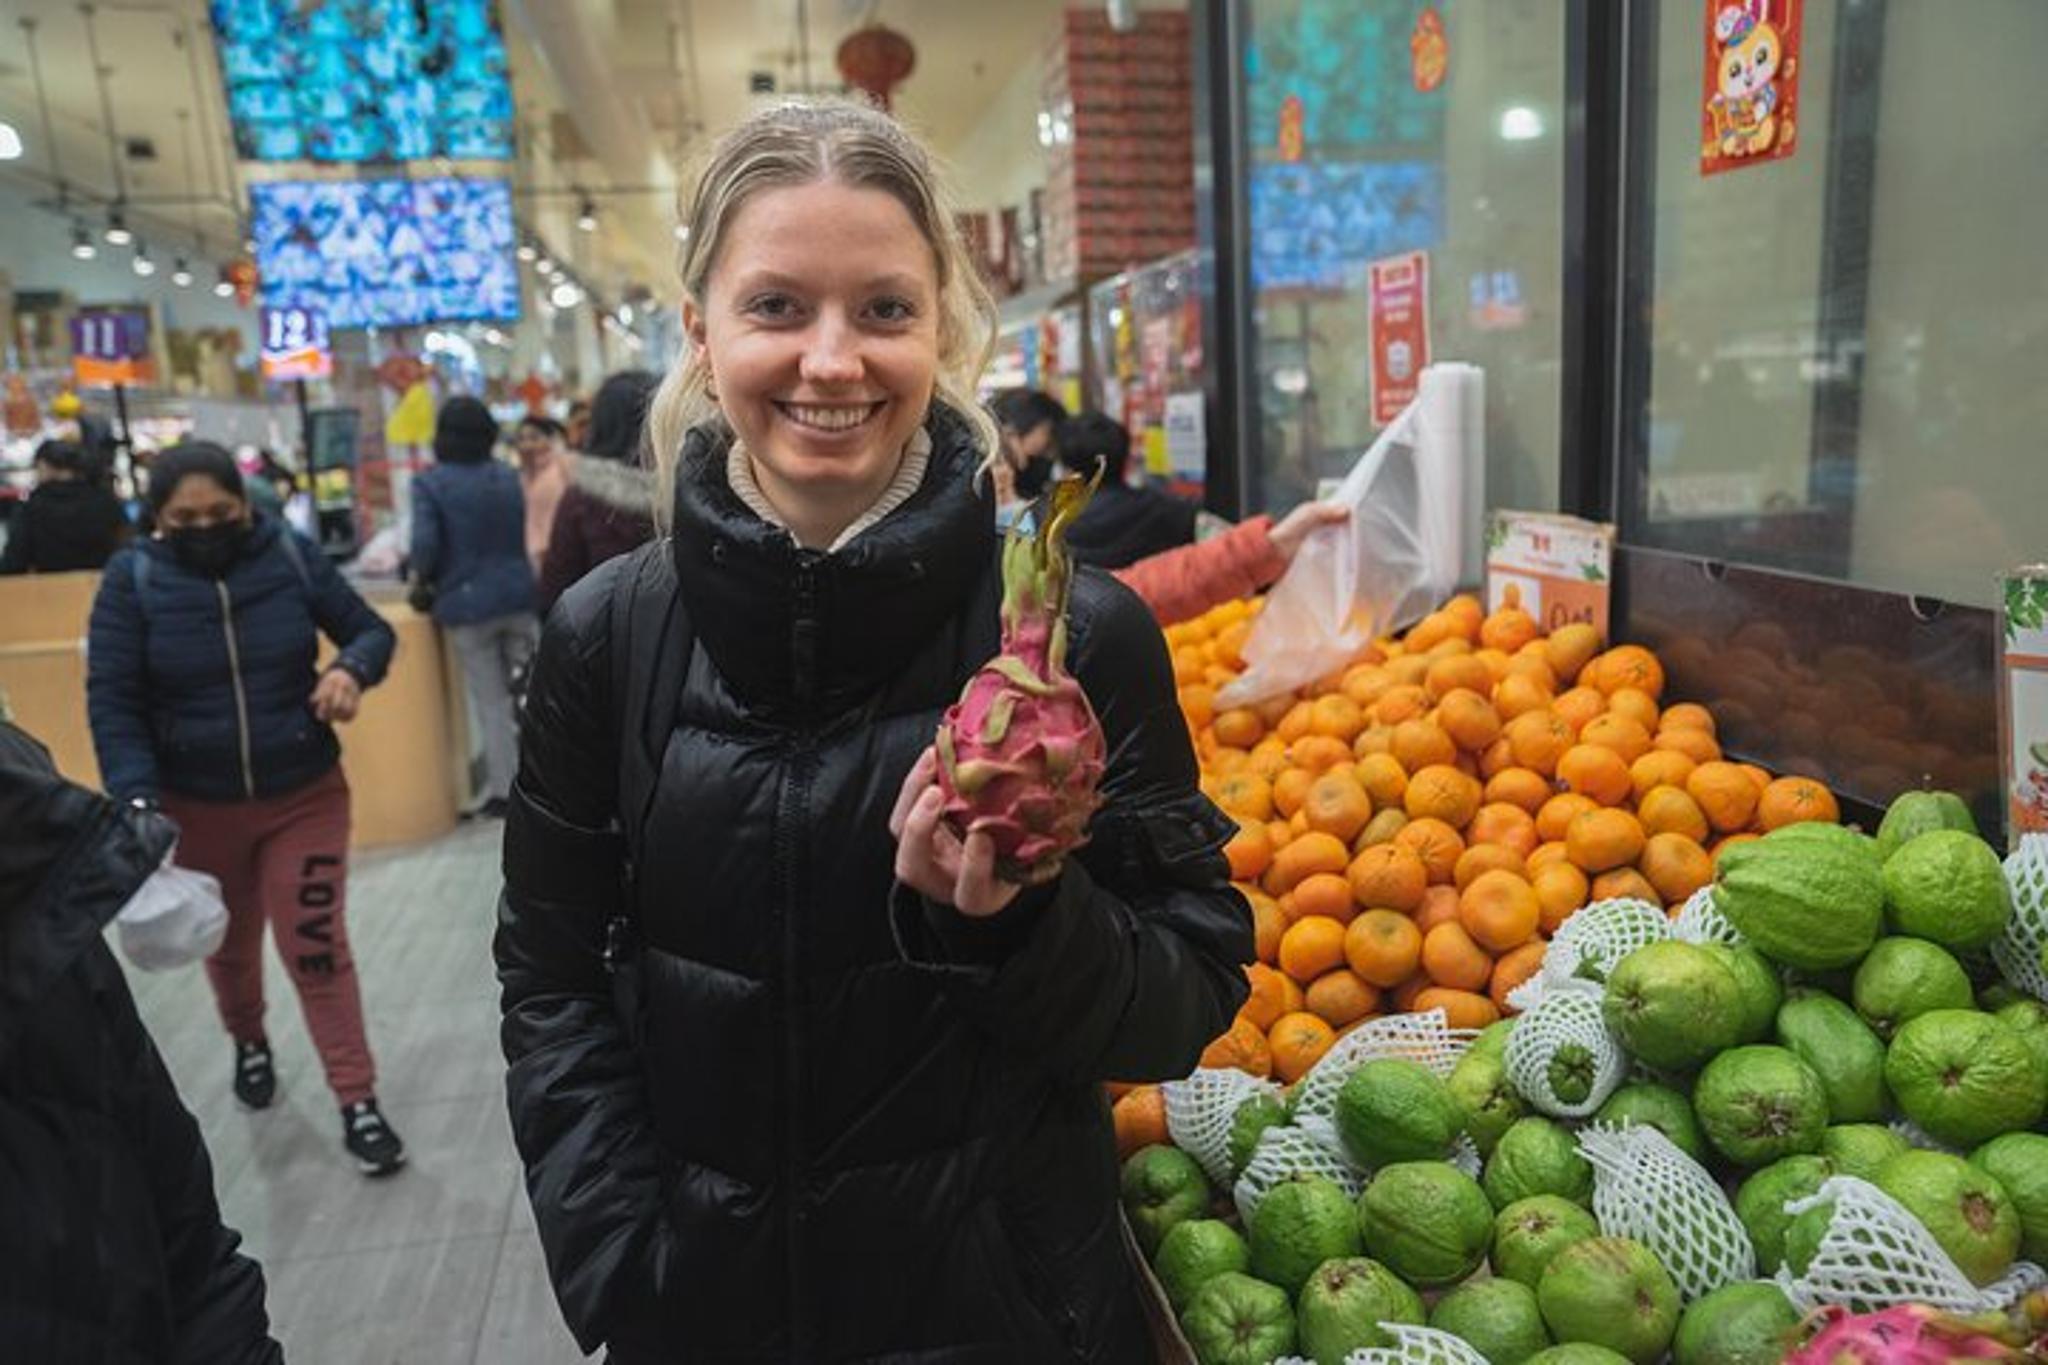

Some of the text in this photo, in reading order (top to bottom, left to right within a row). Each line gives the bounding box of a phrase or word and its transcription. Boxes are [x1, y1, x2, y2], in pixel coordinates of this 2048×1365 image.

[83, 319, 115, 356] 11
[269, 310, 306, 348] 12
[295, 855, 338, 974] LOVE
